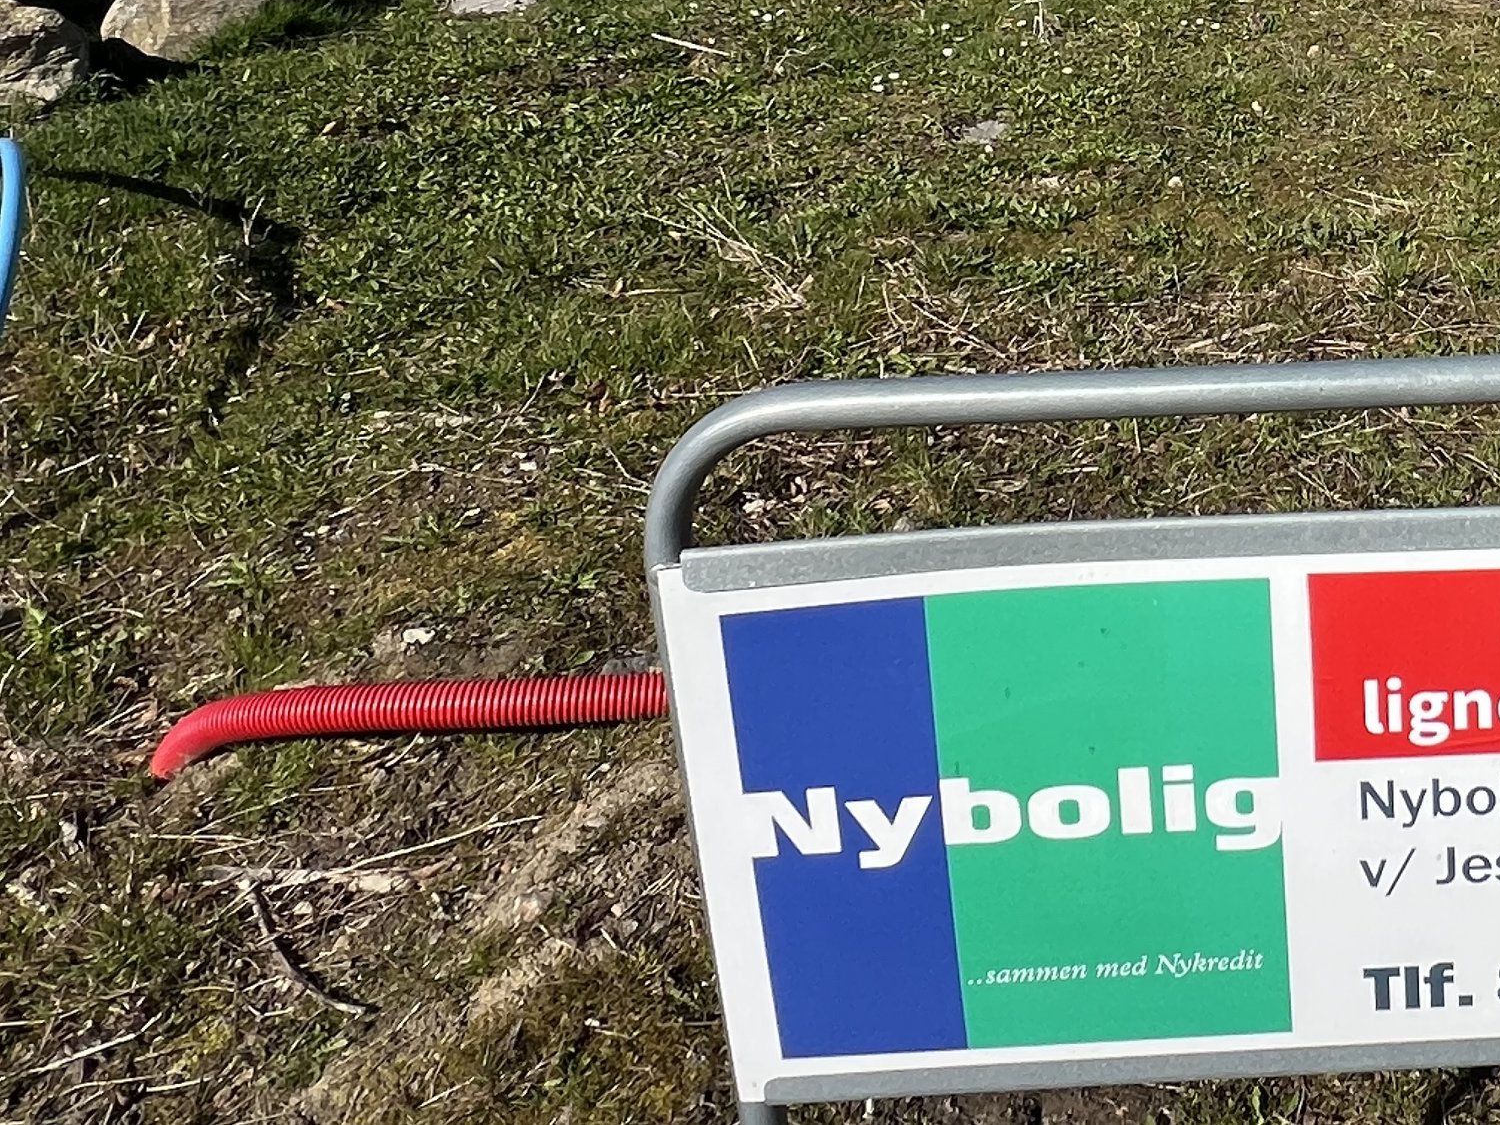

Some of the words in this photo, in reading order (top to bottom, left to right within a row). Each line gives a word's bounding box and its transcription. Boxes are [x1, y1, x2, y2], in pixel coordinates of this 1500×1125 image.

[742, 763, 1283, 869] Nybolig
[1359, 847, 1417, 896] v/
[1095, 954, 1148, 979] med
[1154, 949, 1264, 980] Nykredit
[1363, 961, 1474, 1011] Tlf.
